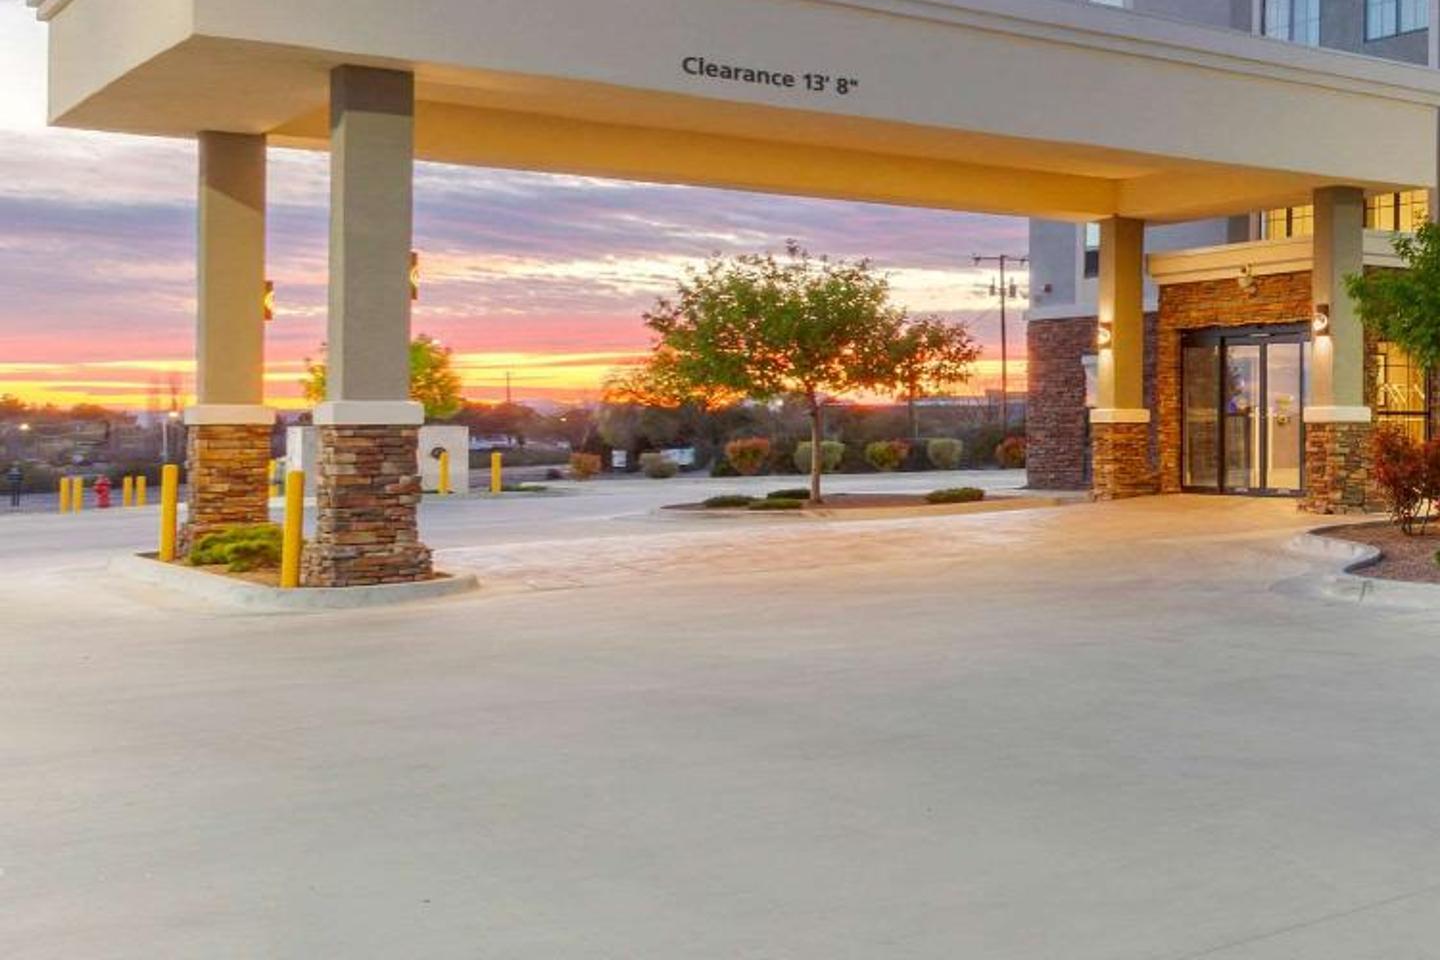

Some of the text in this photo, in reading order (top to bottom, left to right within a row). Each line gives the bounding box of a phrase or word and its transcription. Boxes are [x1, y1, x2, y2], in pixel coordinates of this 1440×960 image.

[682, 56, 859, 96] Clearance 13' 8"
